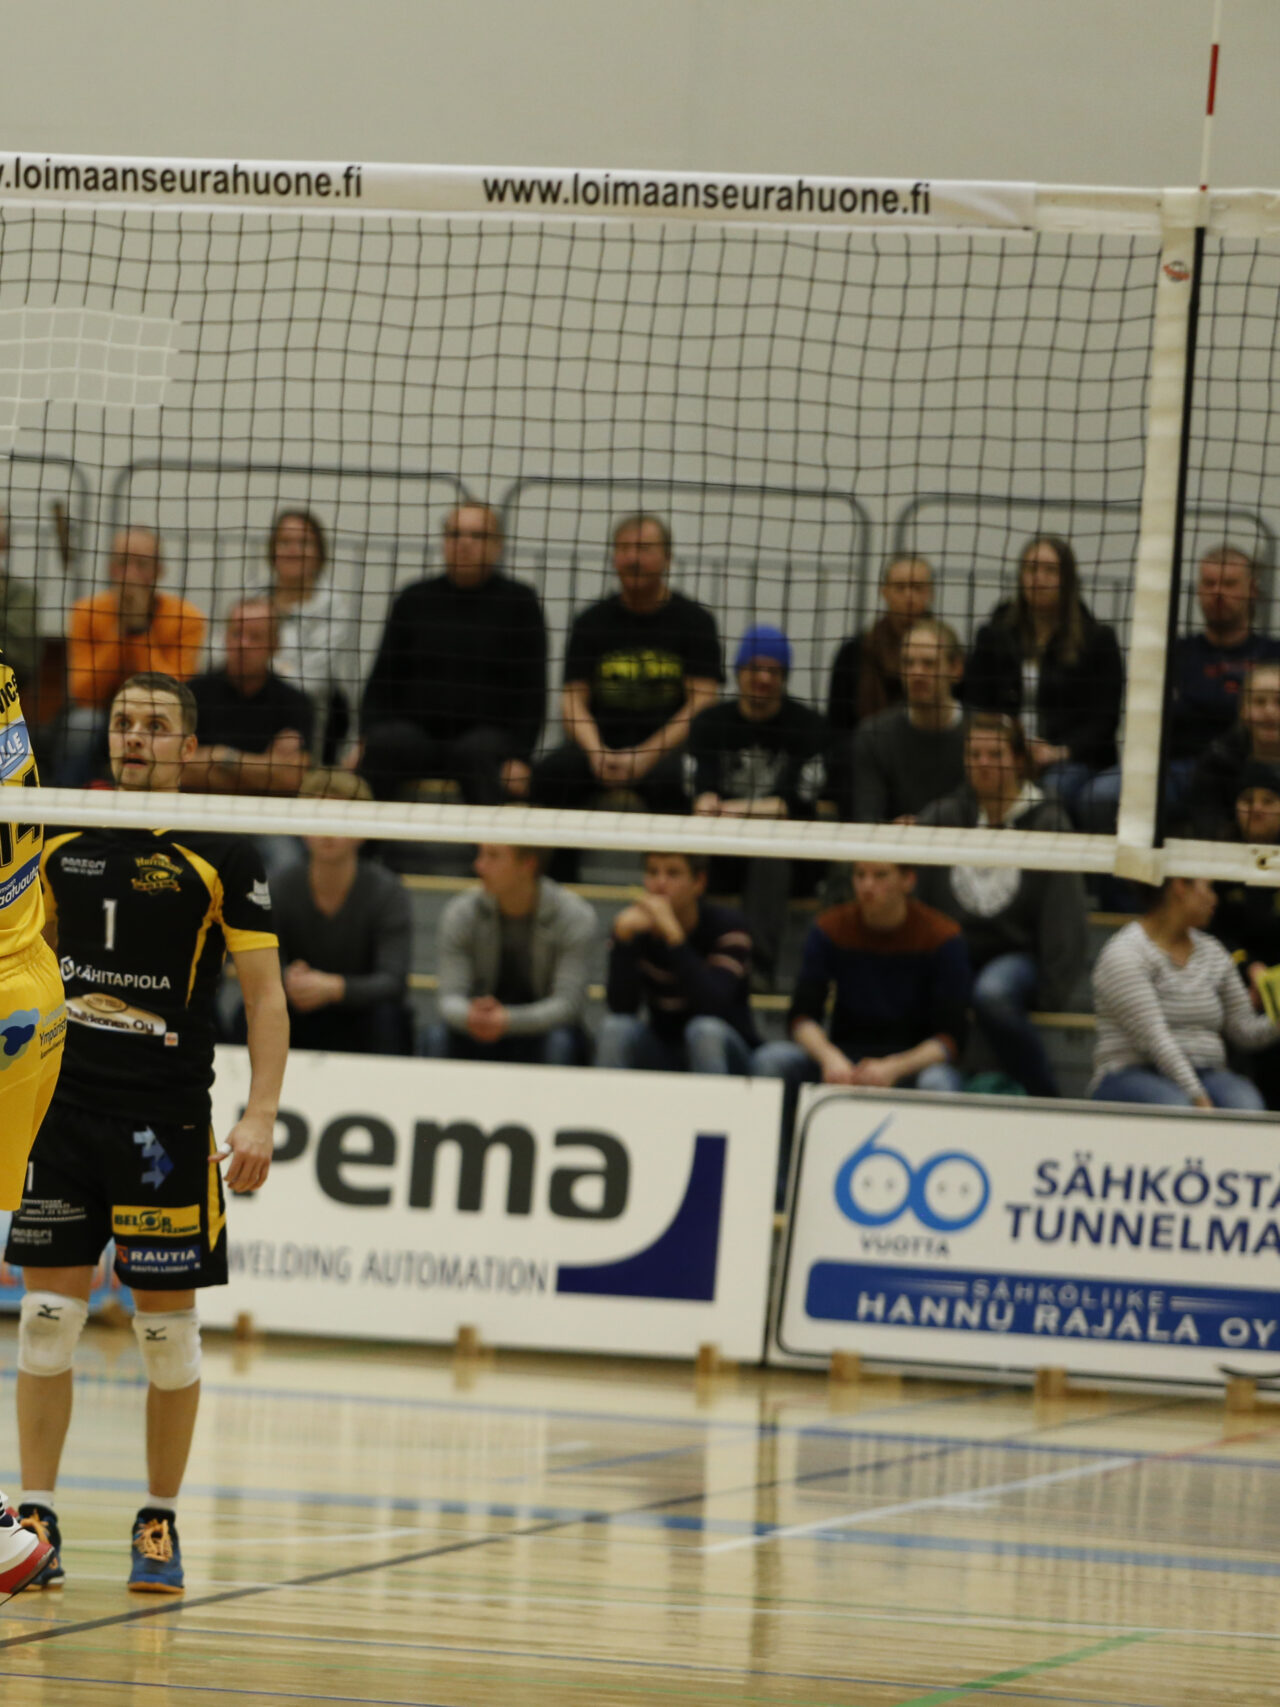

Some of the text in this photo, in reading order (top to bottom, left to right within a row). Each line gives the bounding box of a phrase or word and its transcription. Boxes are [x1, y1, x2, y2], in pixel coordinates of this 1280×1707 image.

[482, 174, 931, 216] www.loimaanseurahuone.fi
[103, 899, 118, 950] 1
[834, 1110, 991, 1233] 60
[130, 1249, 197, 1263] RAUTIA
[861, 1233, 951, 1259] VUOTTA
[361, 1249, 548, 1294] AUTOMATION
[857, 1291, 1278, 1349] HANNU RAJALA OY
